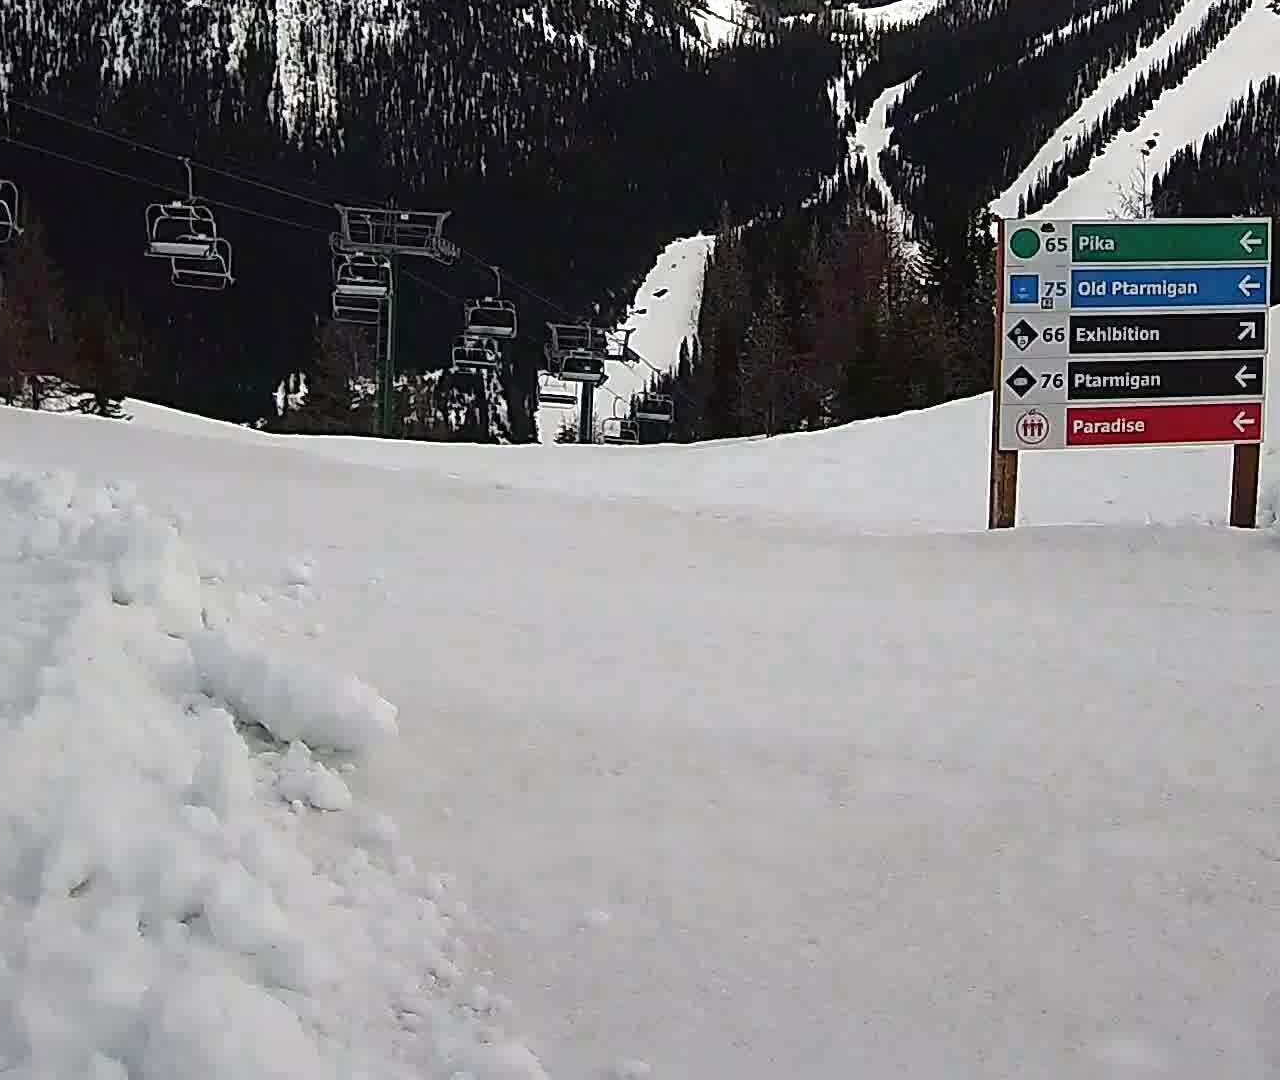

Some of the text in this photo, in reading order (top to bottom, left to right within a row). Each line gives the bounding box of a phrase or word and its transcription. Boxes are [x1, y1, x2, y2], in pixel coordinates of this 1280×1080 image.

[1045, 235, 1115, 253] 65 Pika
[1044, 279, 1198, 299] 75 Old Ptarmigan
[1042, 327, 1065, 343] 66
[1075, 326, 1160, 342] Exhibition
[1040, 371, 1161, 390] 76 Ptarmigan
[1073, 416, 1145, 434] Paradise
